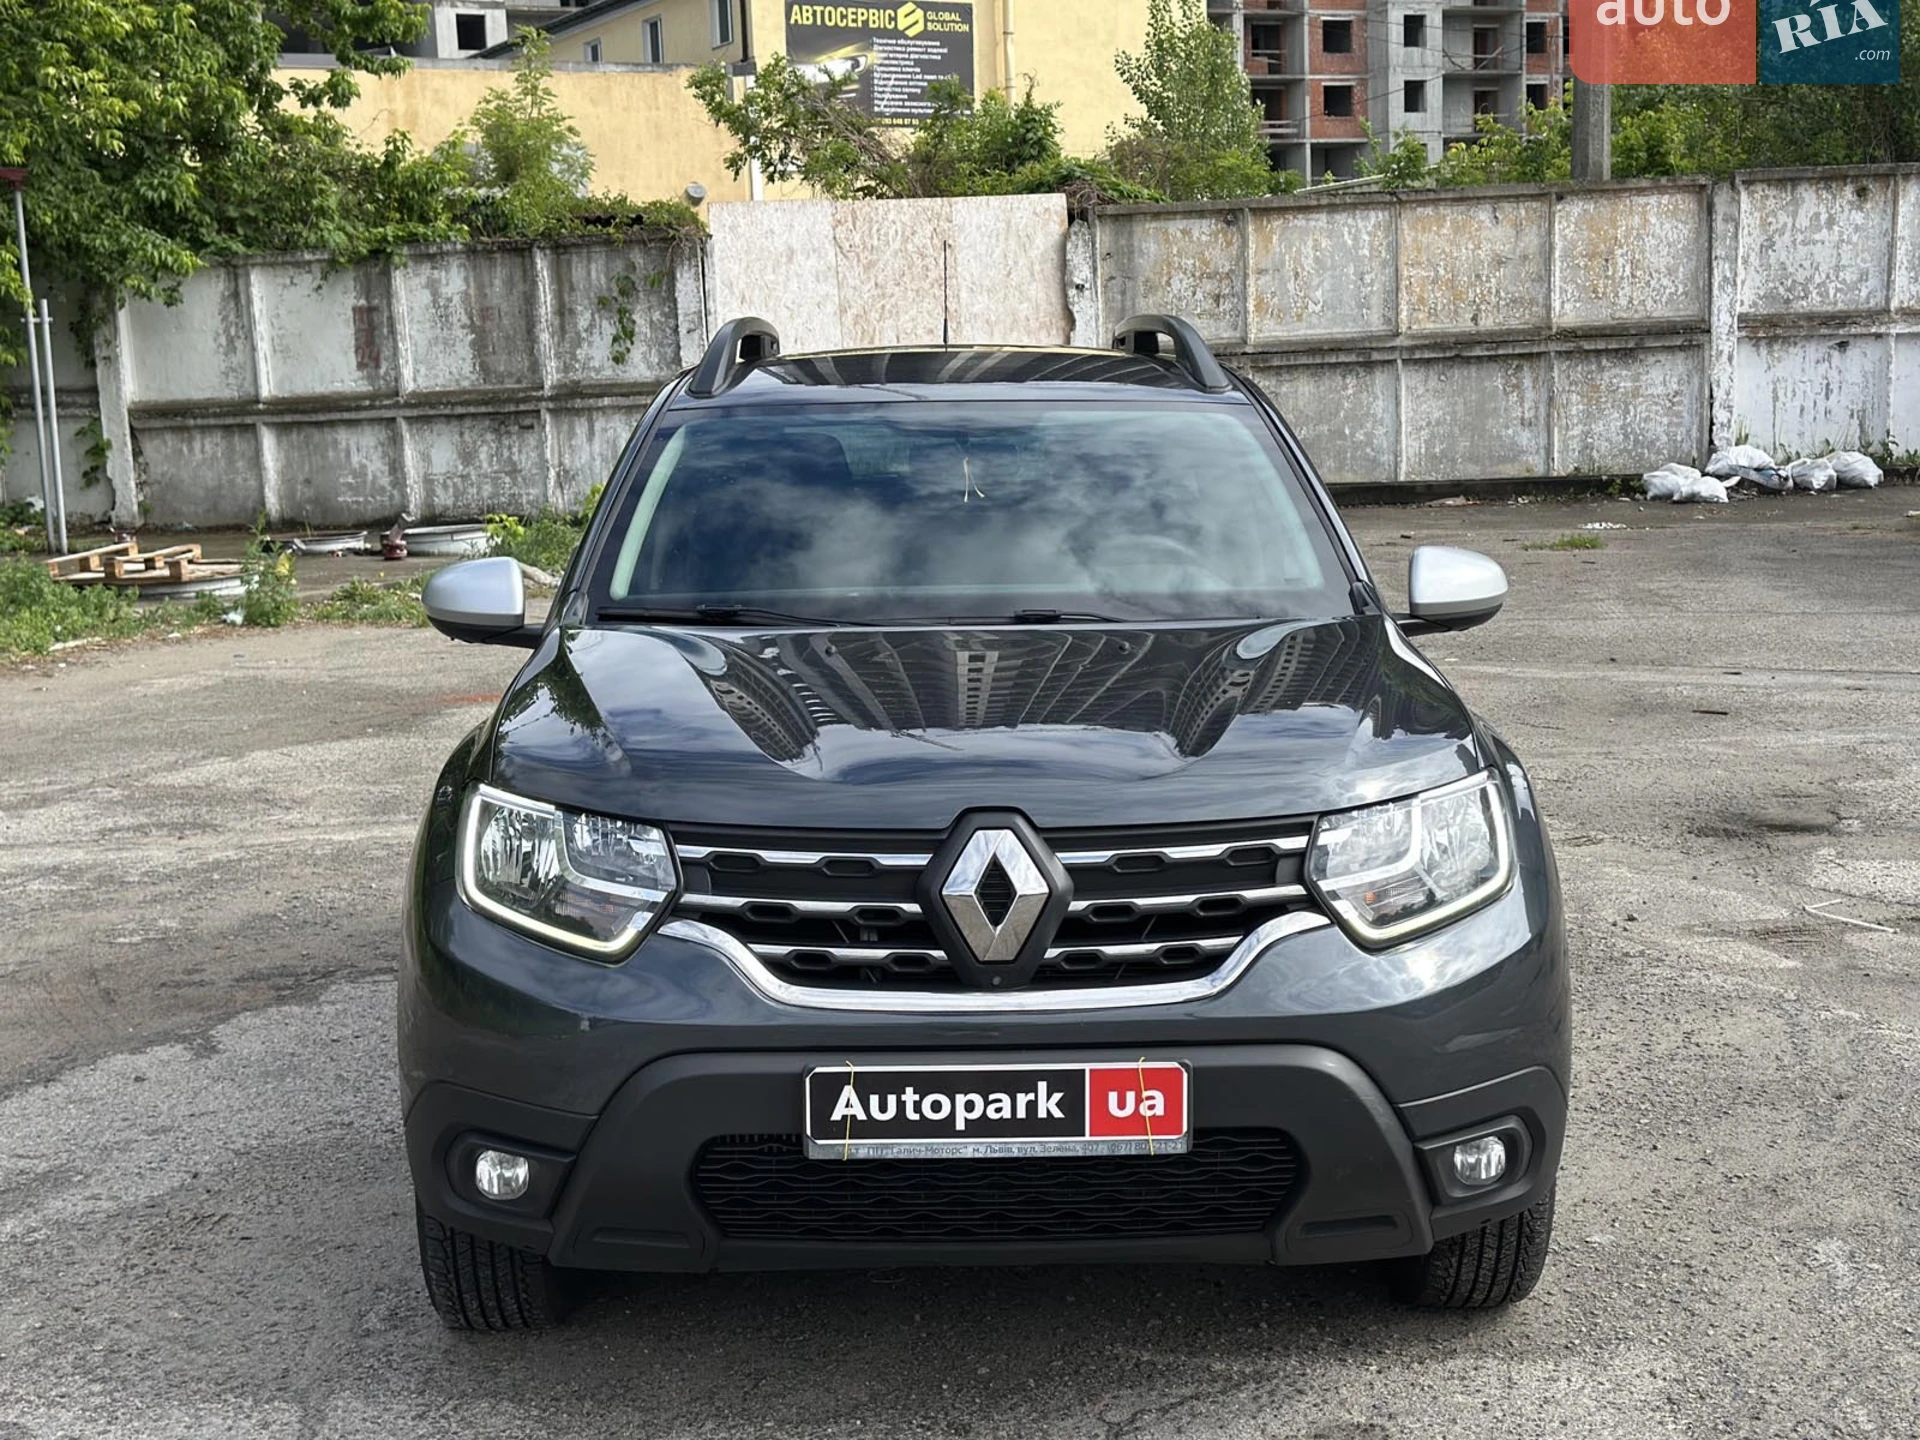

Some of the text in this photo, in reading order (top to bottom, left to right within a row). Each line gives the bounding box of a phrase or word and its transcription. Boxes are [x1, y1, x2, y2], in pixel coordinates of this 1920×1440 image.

[790, 5, 895, 29] АВТОСЕРВІС
[927, 11, 961, 21] GLOBAL
[927, 23, 970, 33] SOLUTION
[830, 1081, 1165, 1130] Autopark ua
